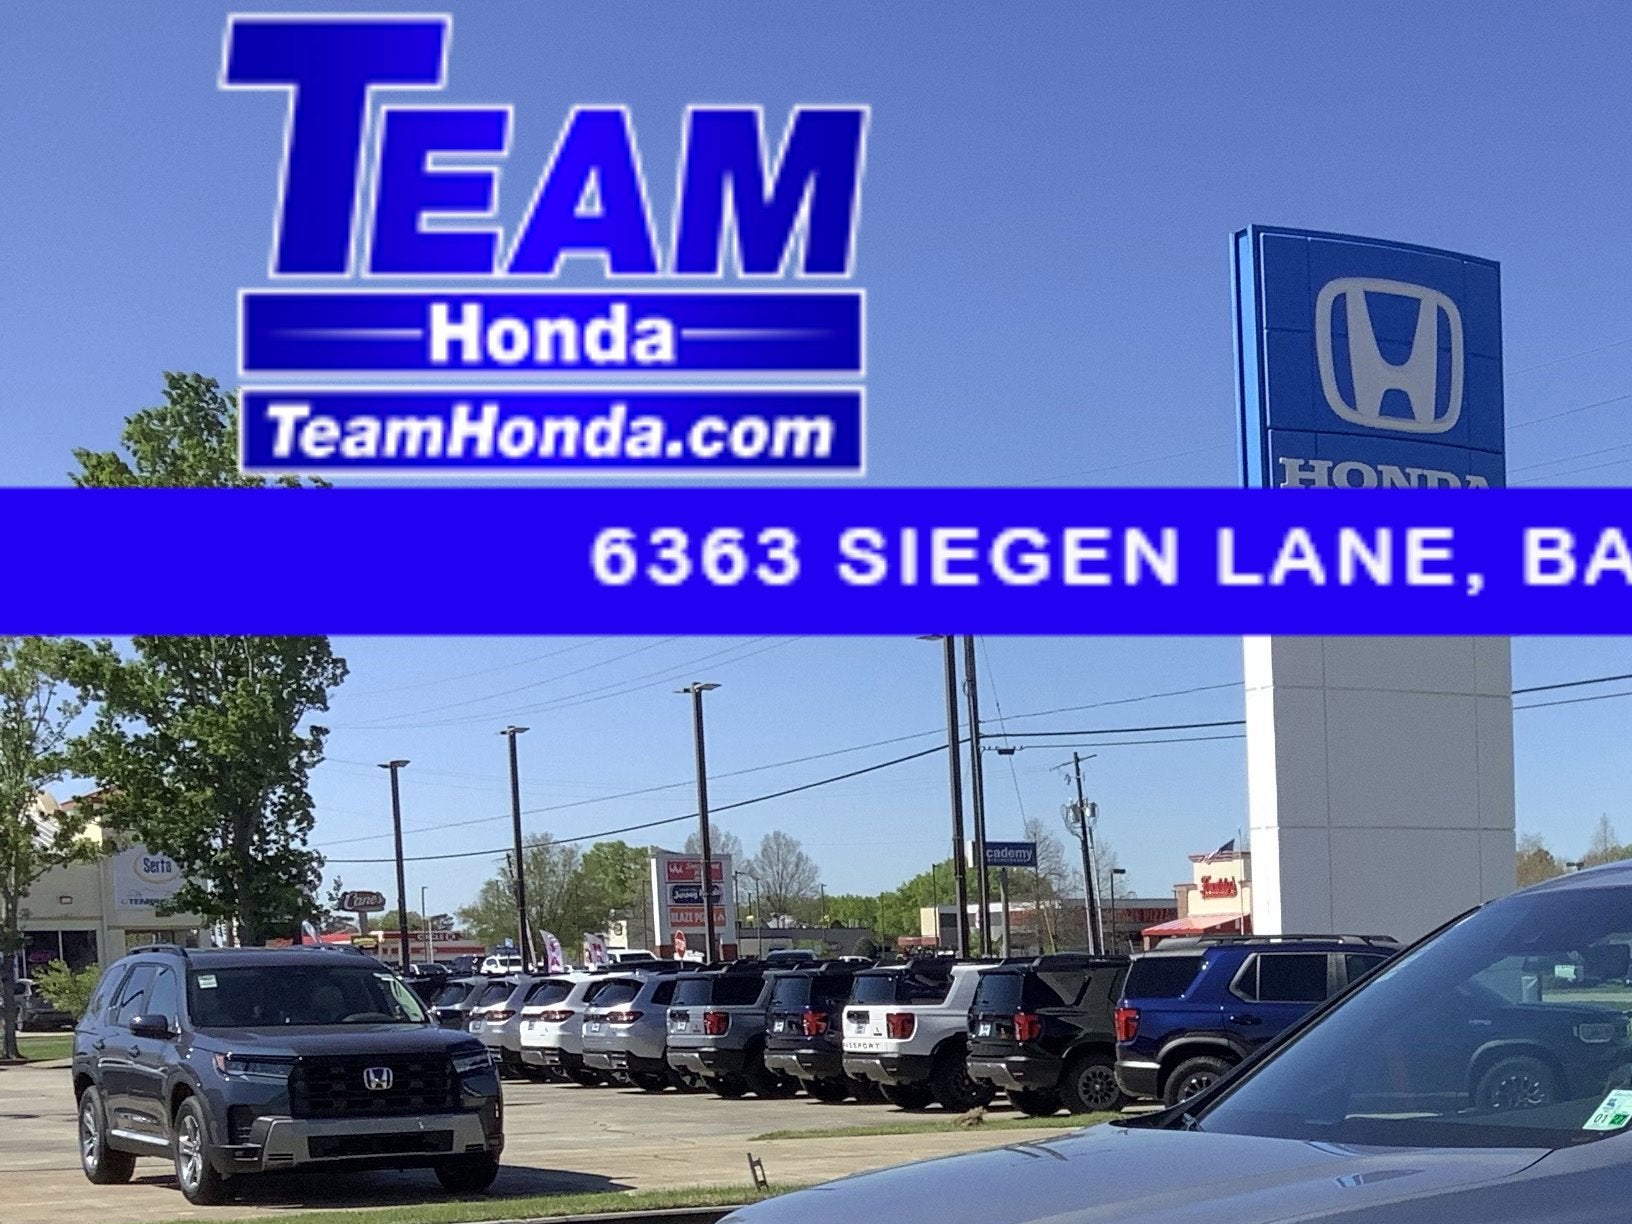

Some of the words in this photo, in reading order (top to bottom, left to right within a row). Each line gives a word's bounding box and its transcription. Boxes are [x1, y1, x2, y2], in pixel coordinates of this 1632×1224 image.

[985, 847, 1033, 862] cademy
[143, 857, 172, 873] Serta
[1594, 1113, 1608, 1123] 01
